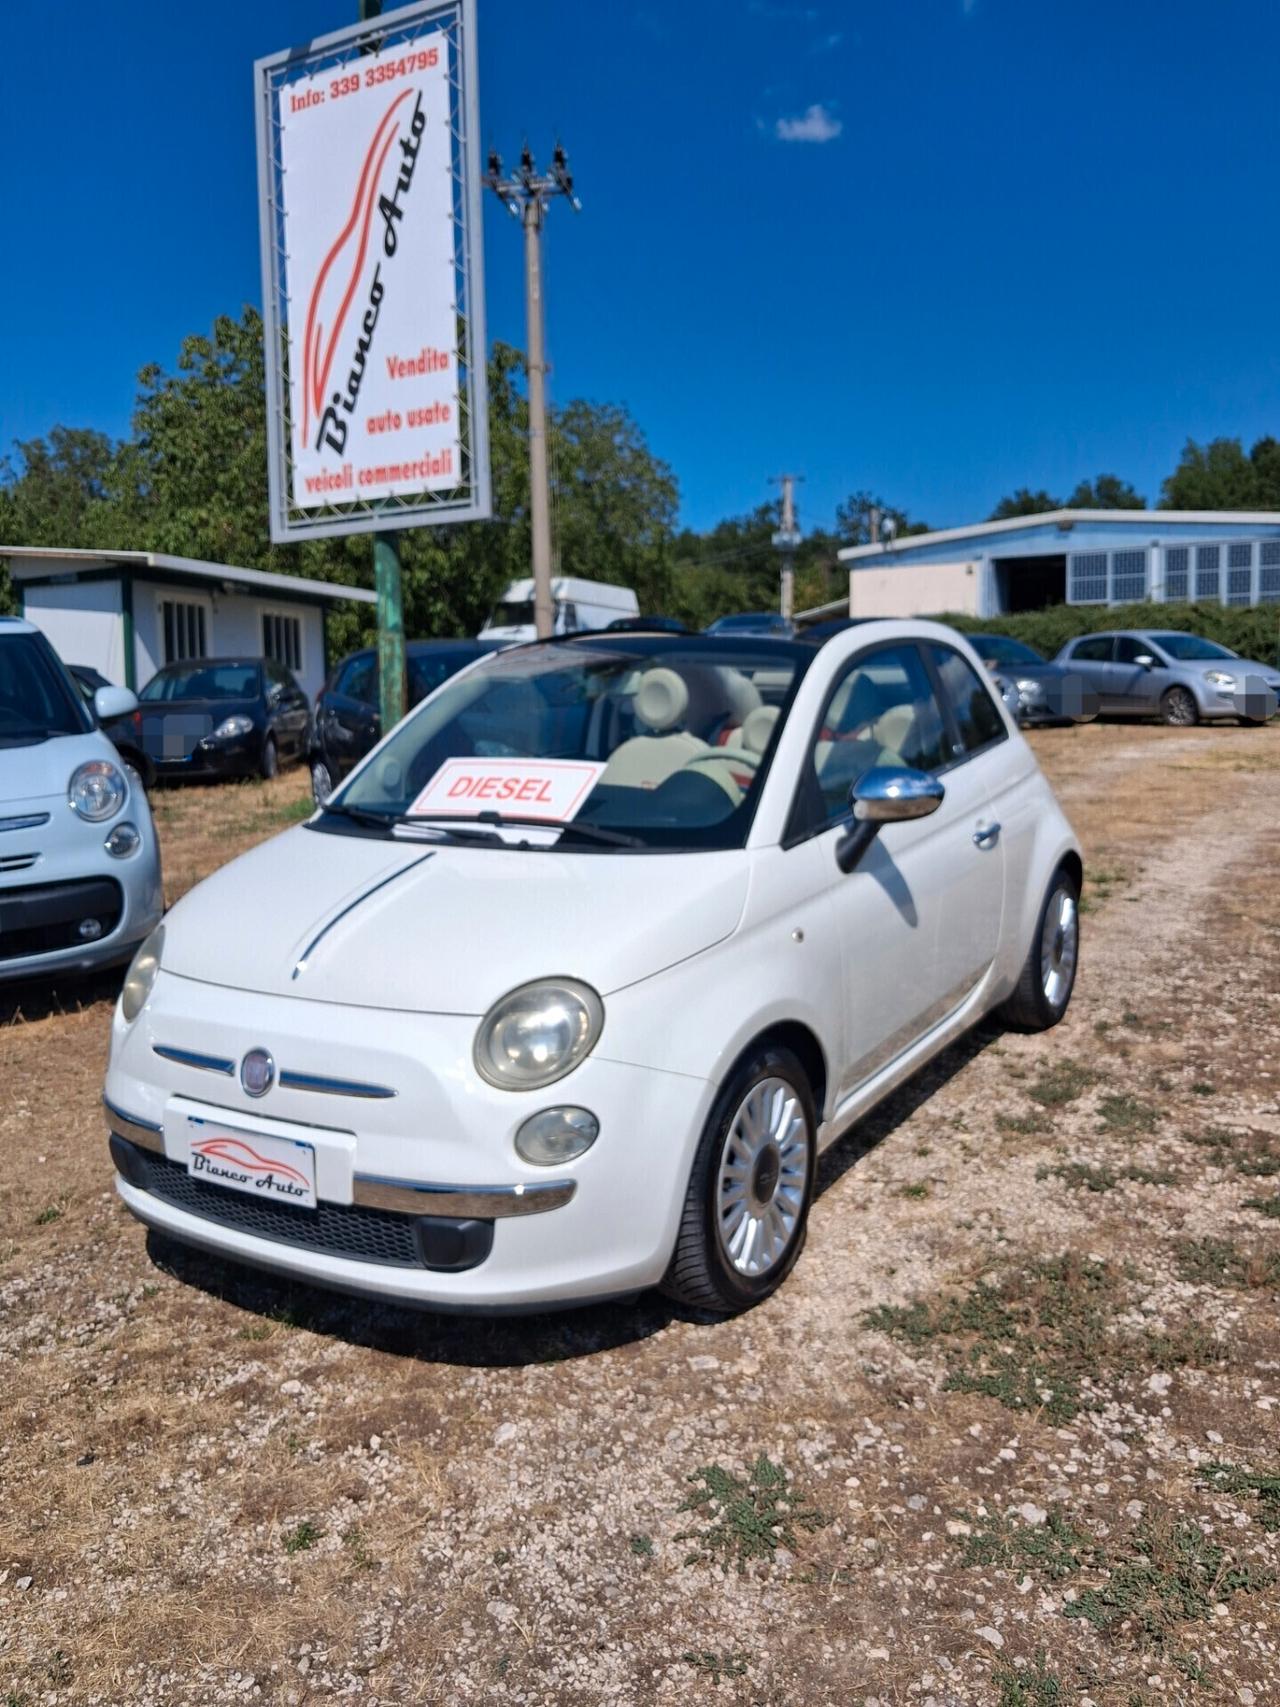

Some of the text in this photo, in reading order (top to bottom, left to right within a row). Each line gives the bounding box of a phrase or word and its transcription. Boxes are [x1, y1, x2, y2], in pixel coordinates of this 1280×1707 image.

[290, 48, 439, 112] Info: 339 3354795
[315, 90, 426, 456] Bianco Auto
[386, 347, 449, 380] Vendita
[367, 401, 450, 435] auto usate
[305, 449, 453, 493] veicoli commerciali
[448, 776, 553, 802] DIESEL
[191, 1152, 309, 1197] Bianco Auto
